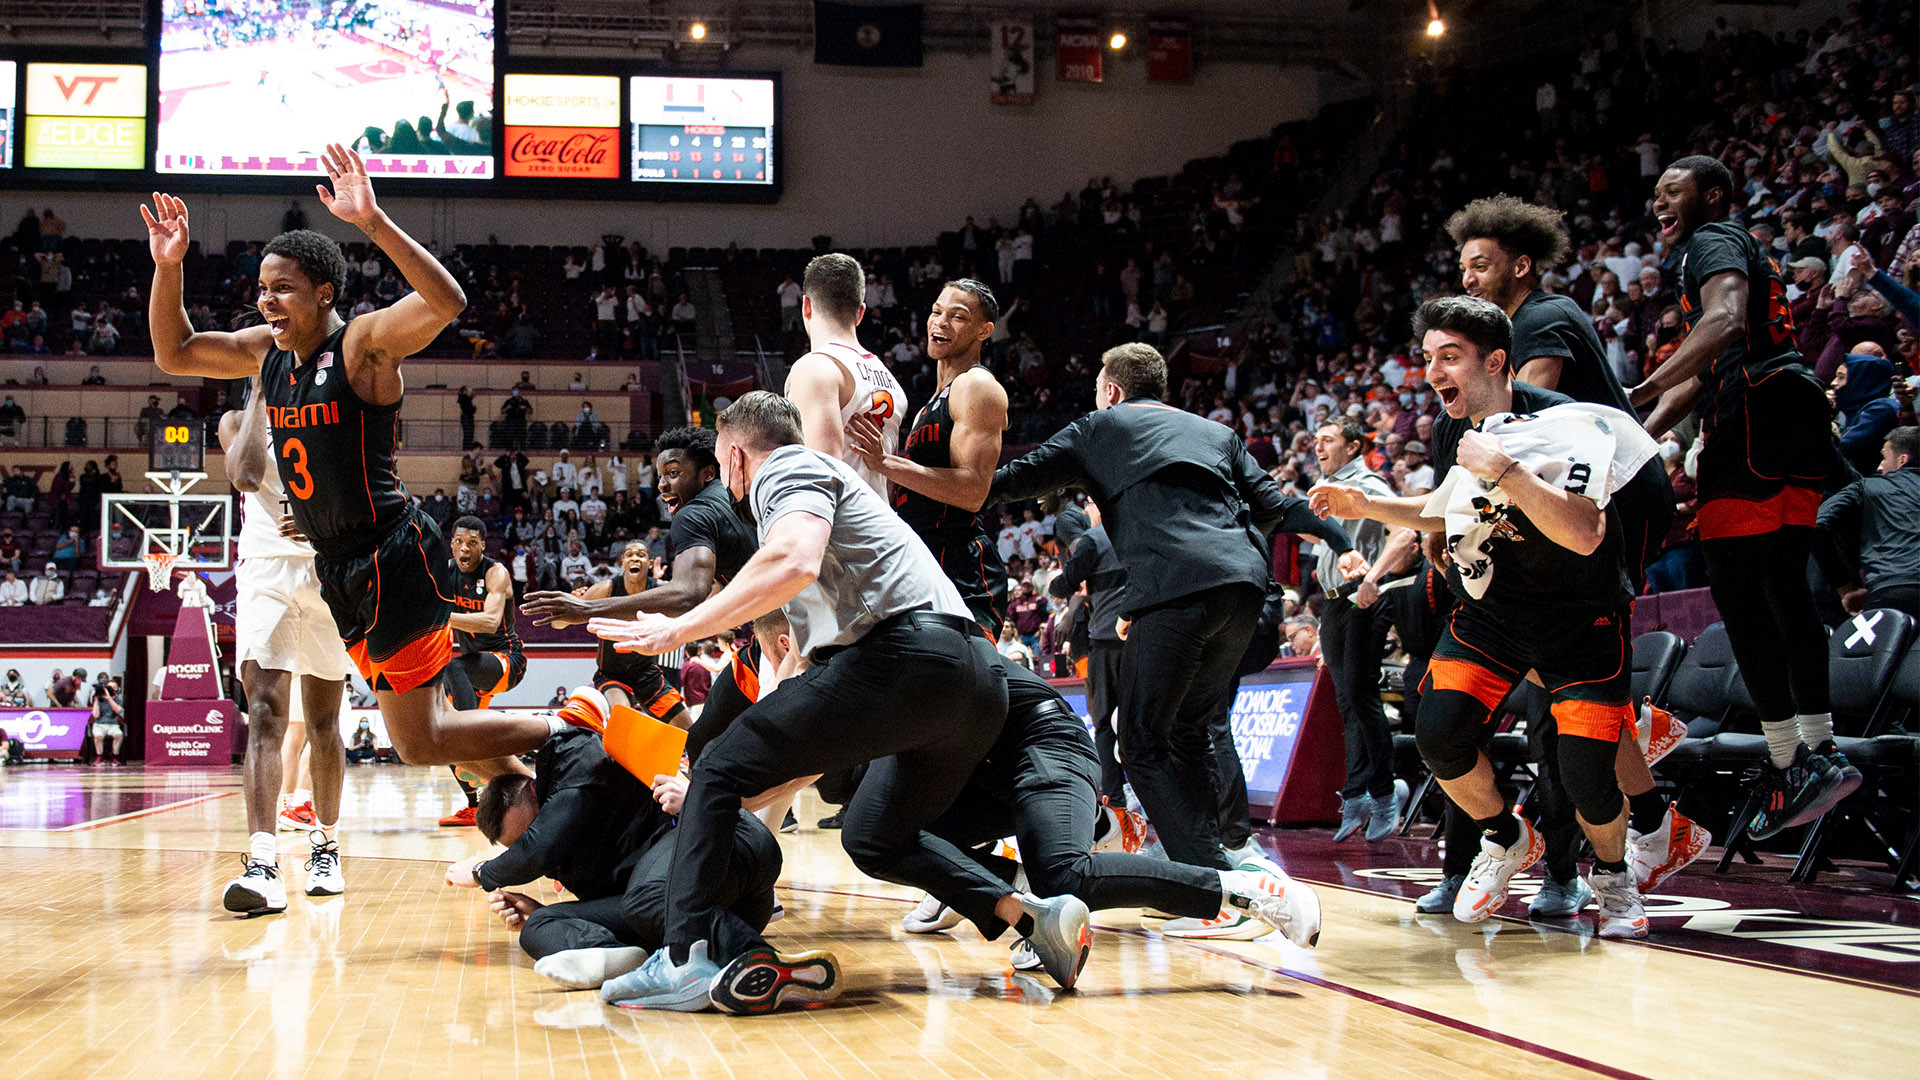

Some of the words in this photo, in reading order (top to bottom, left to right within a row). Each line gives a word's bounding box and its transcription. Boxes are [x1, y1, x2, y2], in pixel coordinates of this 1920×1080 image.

[1001, 25, 1025, 49] 12
[53, 75, 119, 105] VT
[51, 121, 135, 147] EDGE
[511, 132, 614, 165] Coca-Cola
[528, 165, 555, 173] ZERO
[558, 165, 591, 173] SUGAR
[712, 364, 724, 375] 16
[282, 437, 314, 500] 3
[168, 664, 210, 674] ROCKET
[166, 741, 192, 749] Health
[192, 741, 211, 749] Care
[168, 749, 180, 757] for
[181, 749, 208, 757] Hokies
